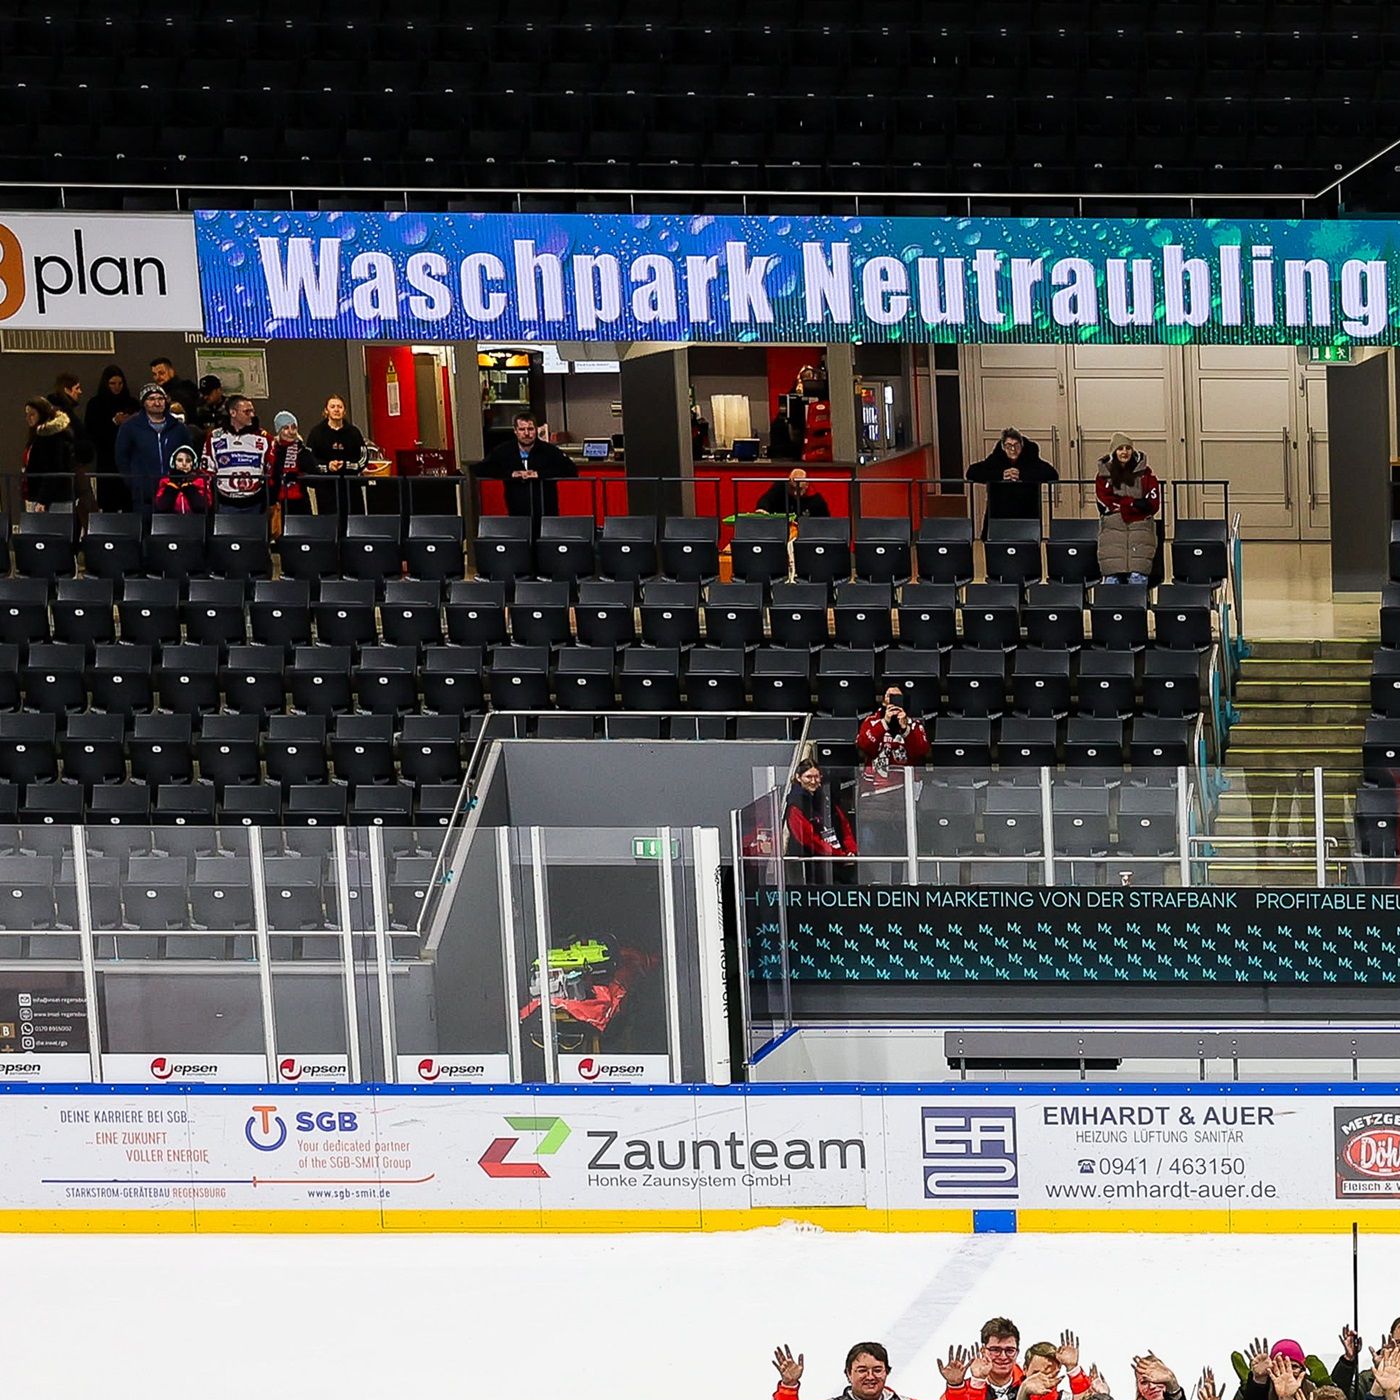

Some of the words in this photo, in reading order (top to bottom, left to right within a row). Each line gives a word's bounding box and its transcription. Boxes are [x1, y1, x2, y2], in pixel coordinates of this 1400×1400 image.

[34, 228, 167, 314] plan
[259, 236, 776, 332] Waschpark
[801, 240, 1388, 337] Neutraubling
[807, 891, 871, 907] HOLEN
[877, 891, 921, 908] DEIN
[925, 891, 1034, 908] MARKETING
[1038, 891, 1079, 908] VON
[1084, 891, 1125, 909] DER
[1130, 891, 1238, 909] STRAFBANK
[1256, 893, 1366, 910] PROFITABLE
[60, 1110, 91, 1123] DEINE
[93, 1110, 144, 1123] KARRIERE
[147, 1110, 164, 1123] BEI
[296, 1111, 358, 1132] SGB
[1043, 1106, 1170, 1125] EMHARDT
[1179, 1106, 1196, 1126] &
[1202, 1106, 1275, 1125] AUER
[122, 1133, 168, 1145] ZUKUNFT
[1076, 1131, 1128, 1143] HEIZUNG
[1133, 1129, 1188, 1143] LÜFTUNG
[1194, 1129, 1244, 1143] SANITÄR
[297, 1140, 320, 1153] Your
[323, 1139, 371, 1152] dedicated
[375, 1141, 411, 1155] partner
[587, 1130, 867, 1171] Zaunteam
[126, 1149, 164, 1162] VOLLER
[167, 1149, 209, 1164] ENERGIE
[299, 1157, 309, 1168] of
[311, 1157, 327, 1168] the
[330, 1157, 379, 1169] SGB-SMIT
[382, 1157, 412, 1171] Group
[1099, 1158, 1148, 1175] 0941
[1156, 1157, 1163, 1176] /
[1169, 1158, 1245, 1176] 463150
[588, 1174, 637, 1187] Honke
[643, 1174, 737, 1190] Zaunsystem
[744, 1174, 791, 1187] GmbH
[1045, 1181, 1277, 1199] www.emhardt-auer.de
[1343, 1182, 1381, 1192] Fleisch
[1385, 1182, 1392, 1192] &
[65, 1186, 170, 1199] STARKSTROM-GERÄTEBAU
[172, 1188, 226, 1199] REGENSBURG
[307, 1188, 391, 1200] www.sgb-smit.de
